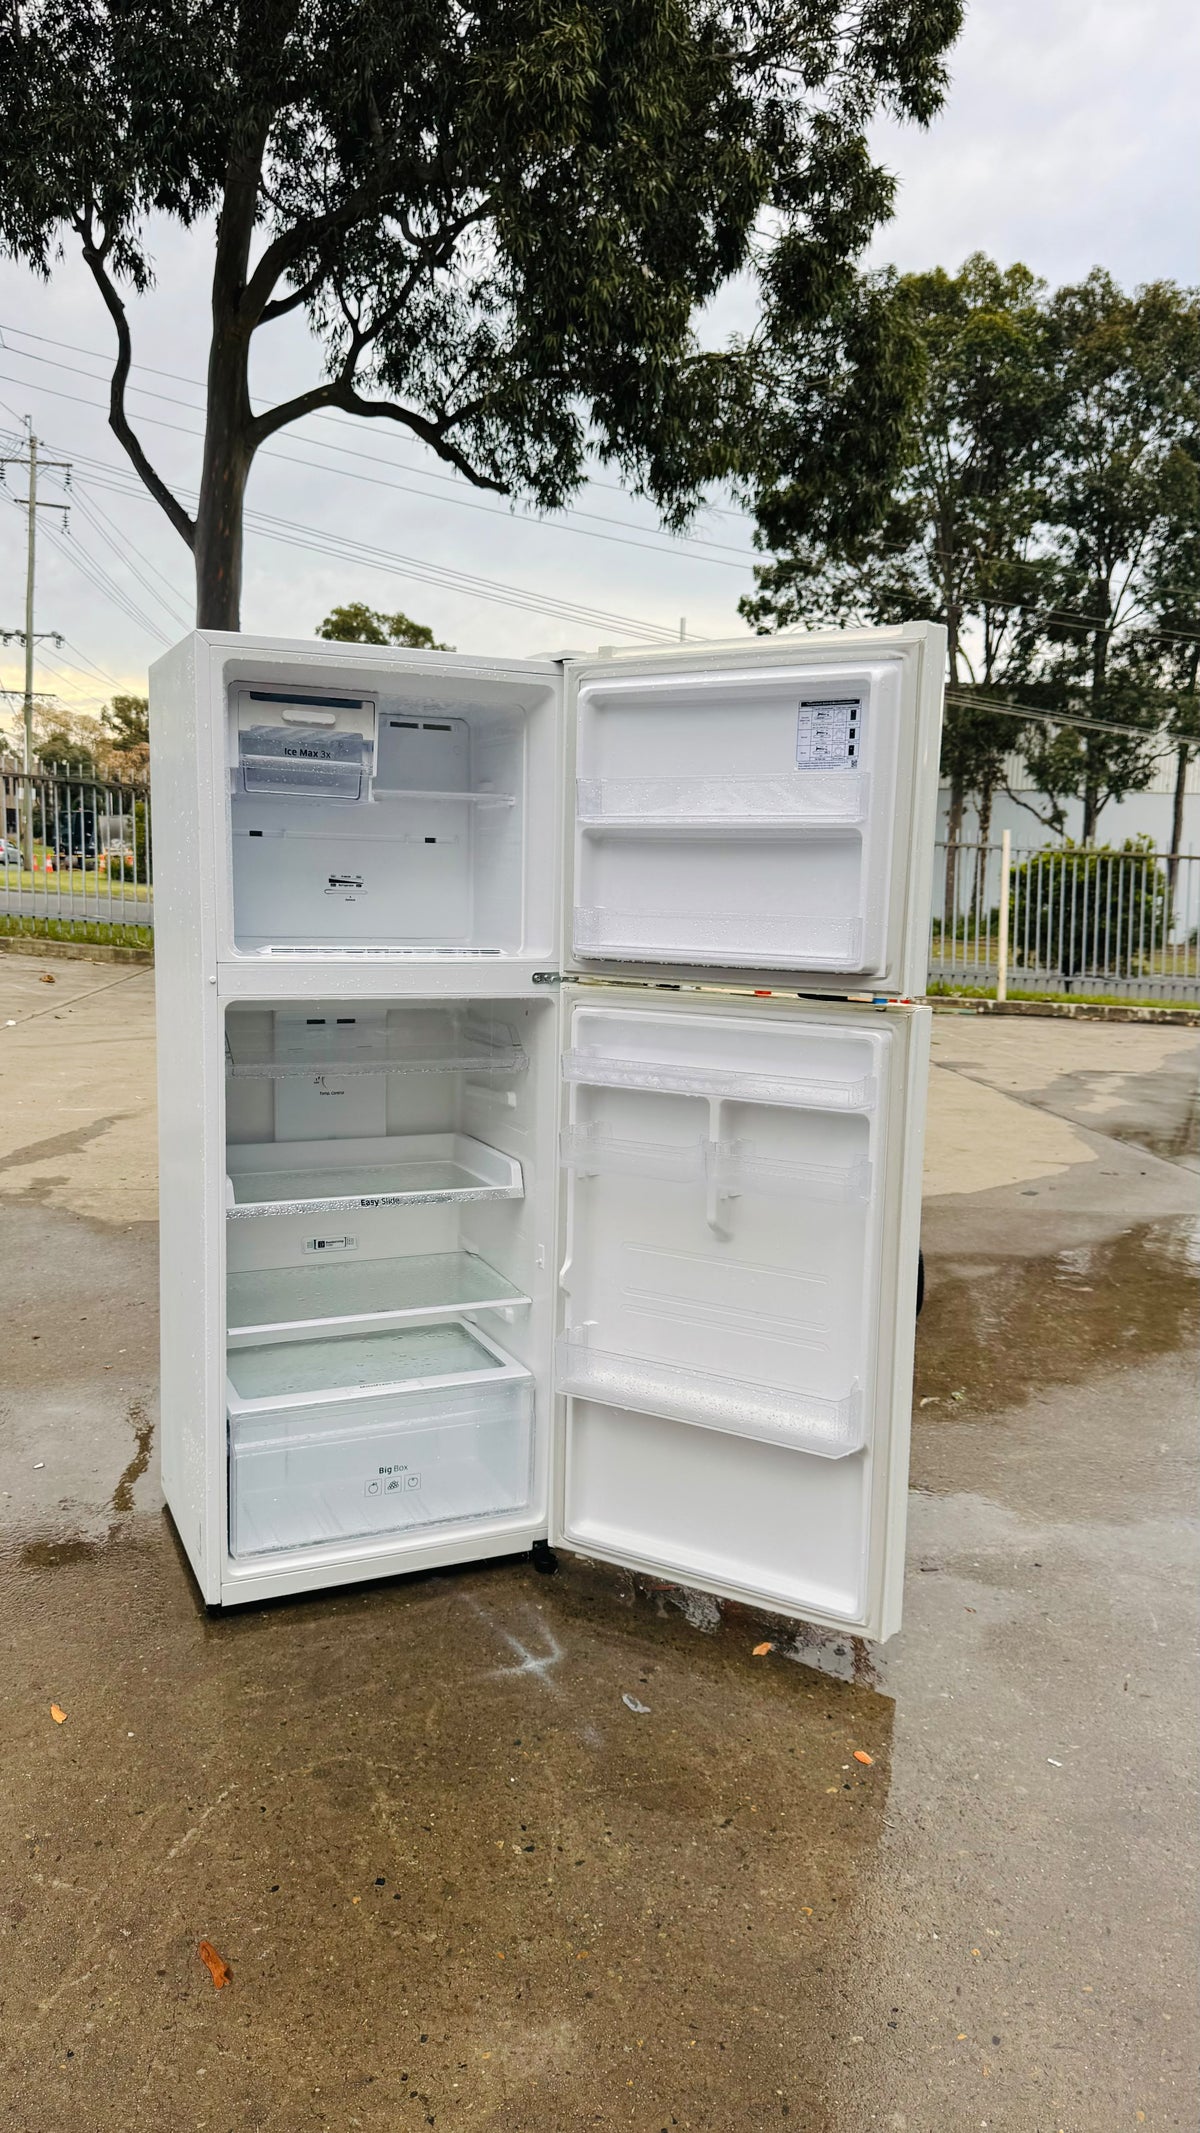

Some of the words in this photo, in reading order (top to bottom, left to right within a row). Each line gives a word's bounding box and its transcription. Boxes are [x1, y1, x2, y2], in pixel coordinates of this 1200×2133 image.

[284, 747, 298, 756] Ice
[299, 748, 319, 758] Max
[320, 750, 331, 759] 3x
[360, 1199, 379, 1207] Easy
[381, 1197, 400, 1205] Slide
[379, 1466, 392, 1475] Big
[393, 1464, 408, 1472] Box
